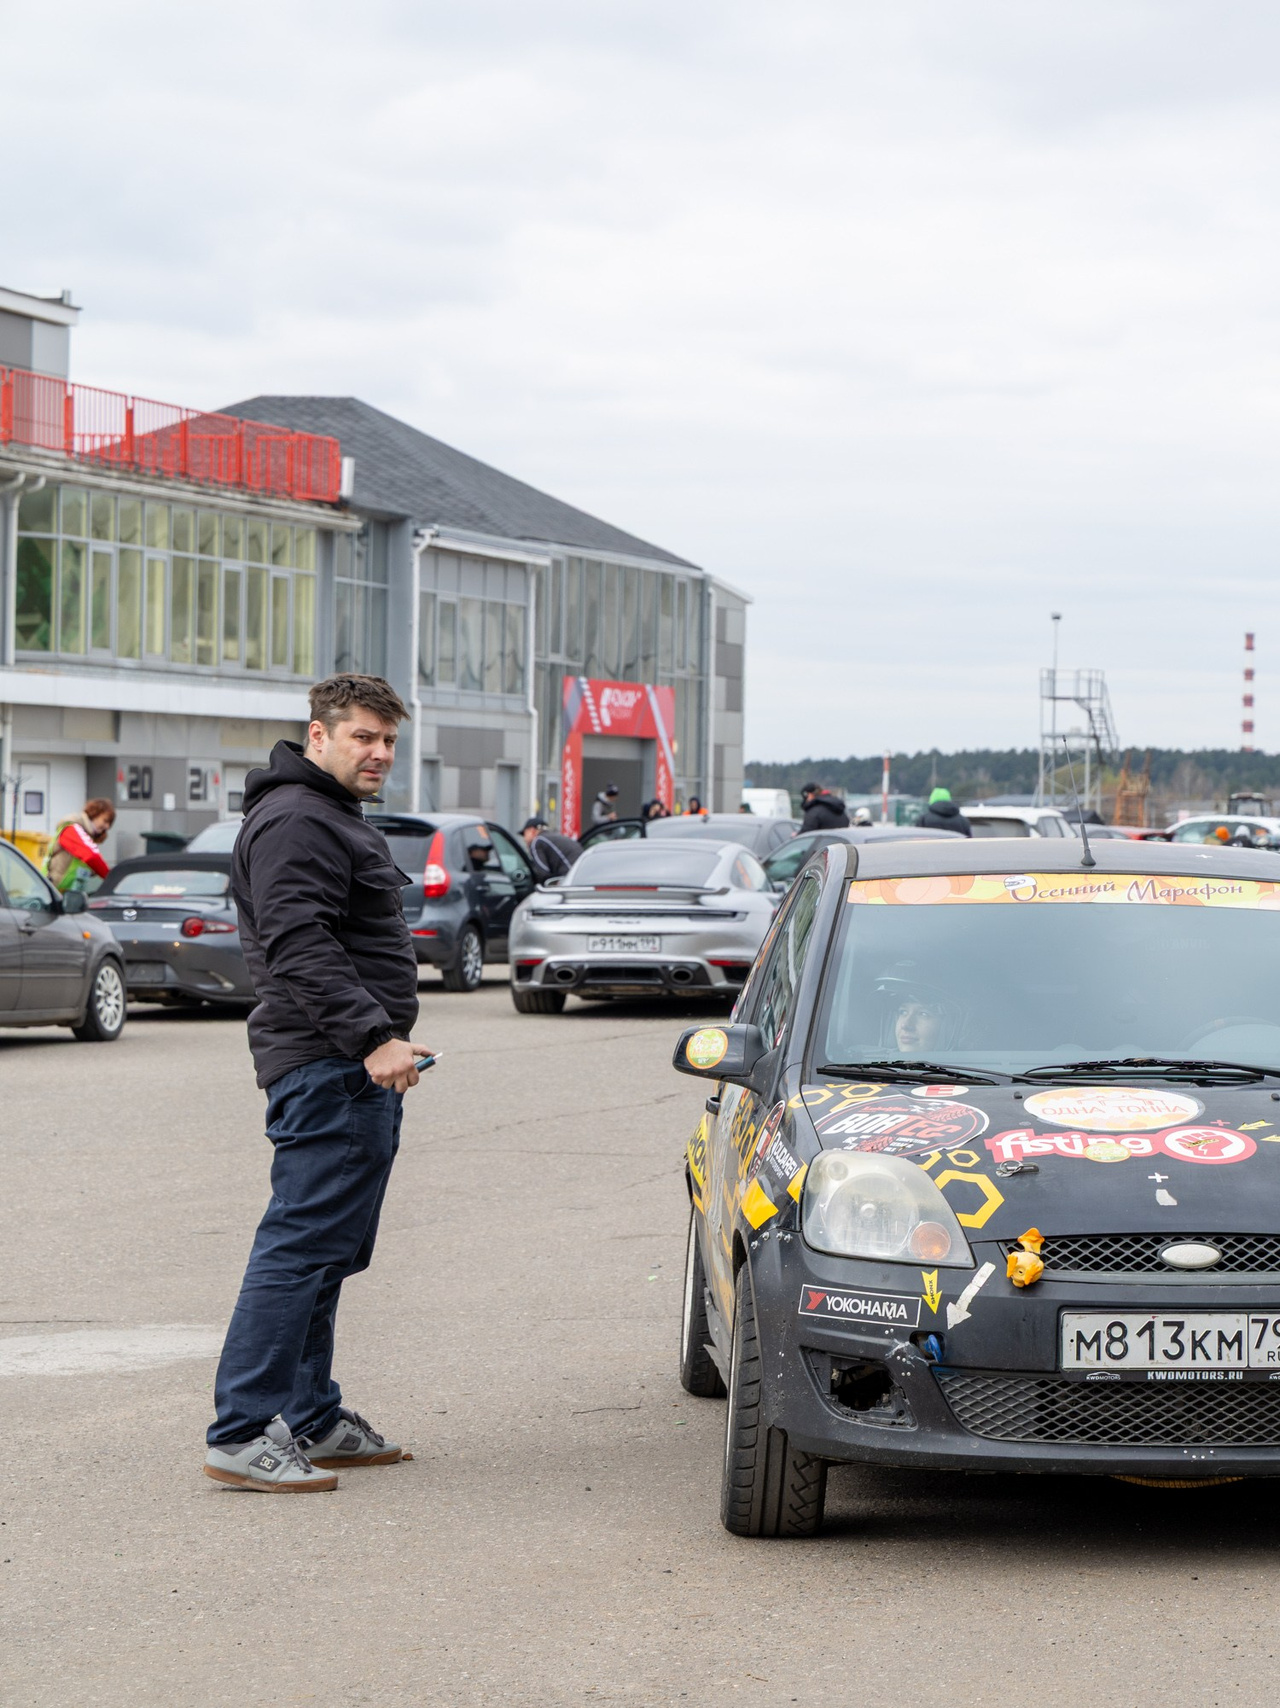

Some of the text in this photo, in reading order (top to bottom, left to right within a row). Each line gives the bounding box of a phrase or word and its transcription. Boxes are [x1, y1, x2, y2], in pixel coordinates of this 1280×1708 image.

[128, 765, 152, 800] 20
[1010, 879, 1244, 902] Осенний Марафон
[1041, 1104, 1190, 1116] ОДНА ТОННА
[821, 1113, 962, 1138] BORTEC
[826, 1295, 908, 1319] YOKOHAMA
[1075, 1320, 1243, 1361] М813КМ
